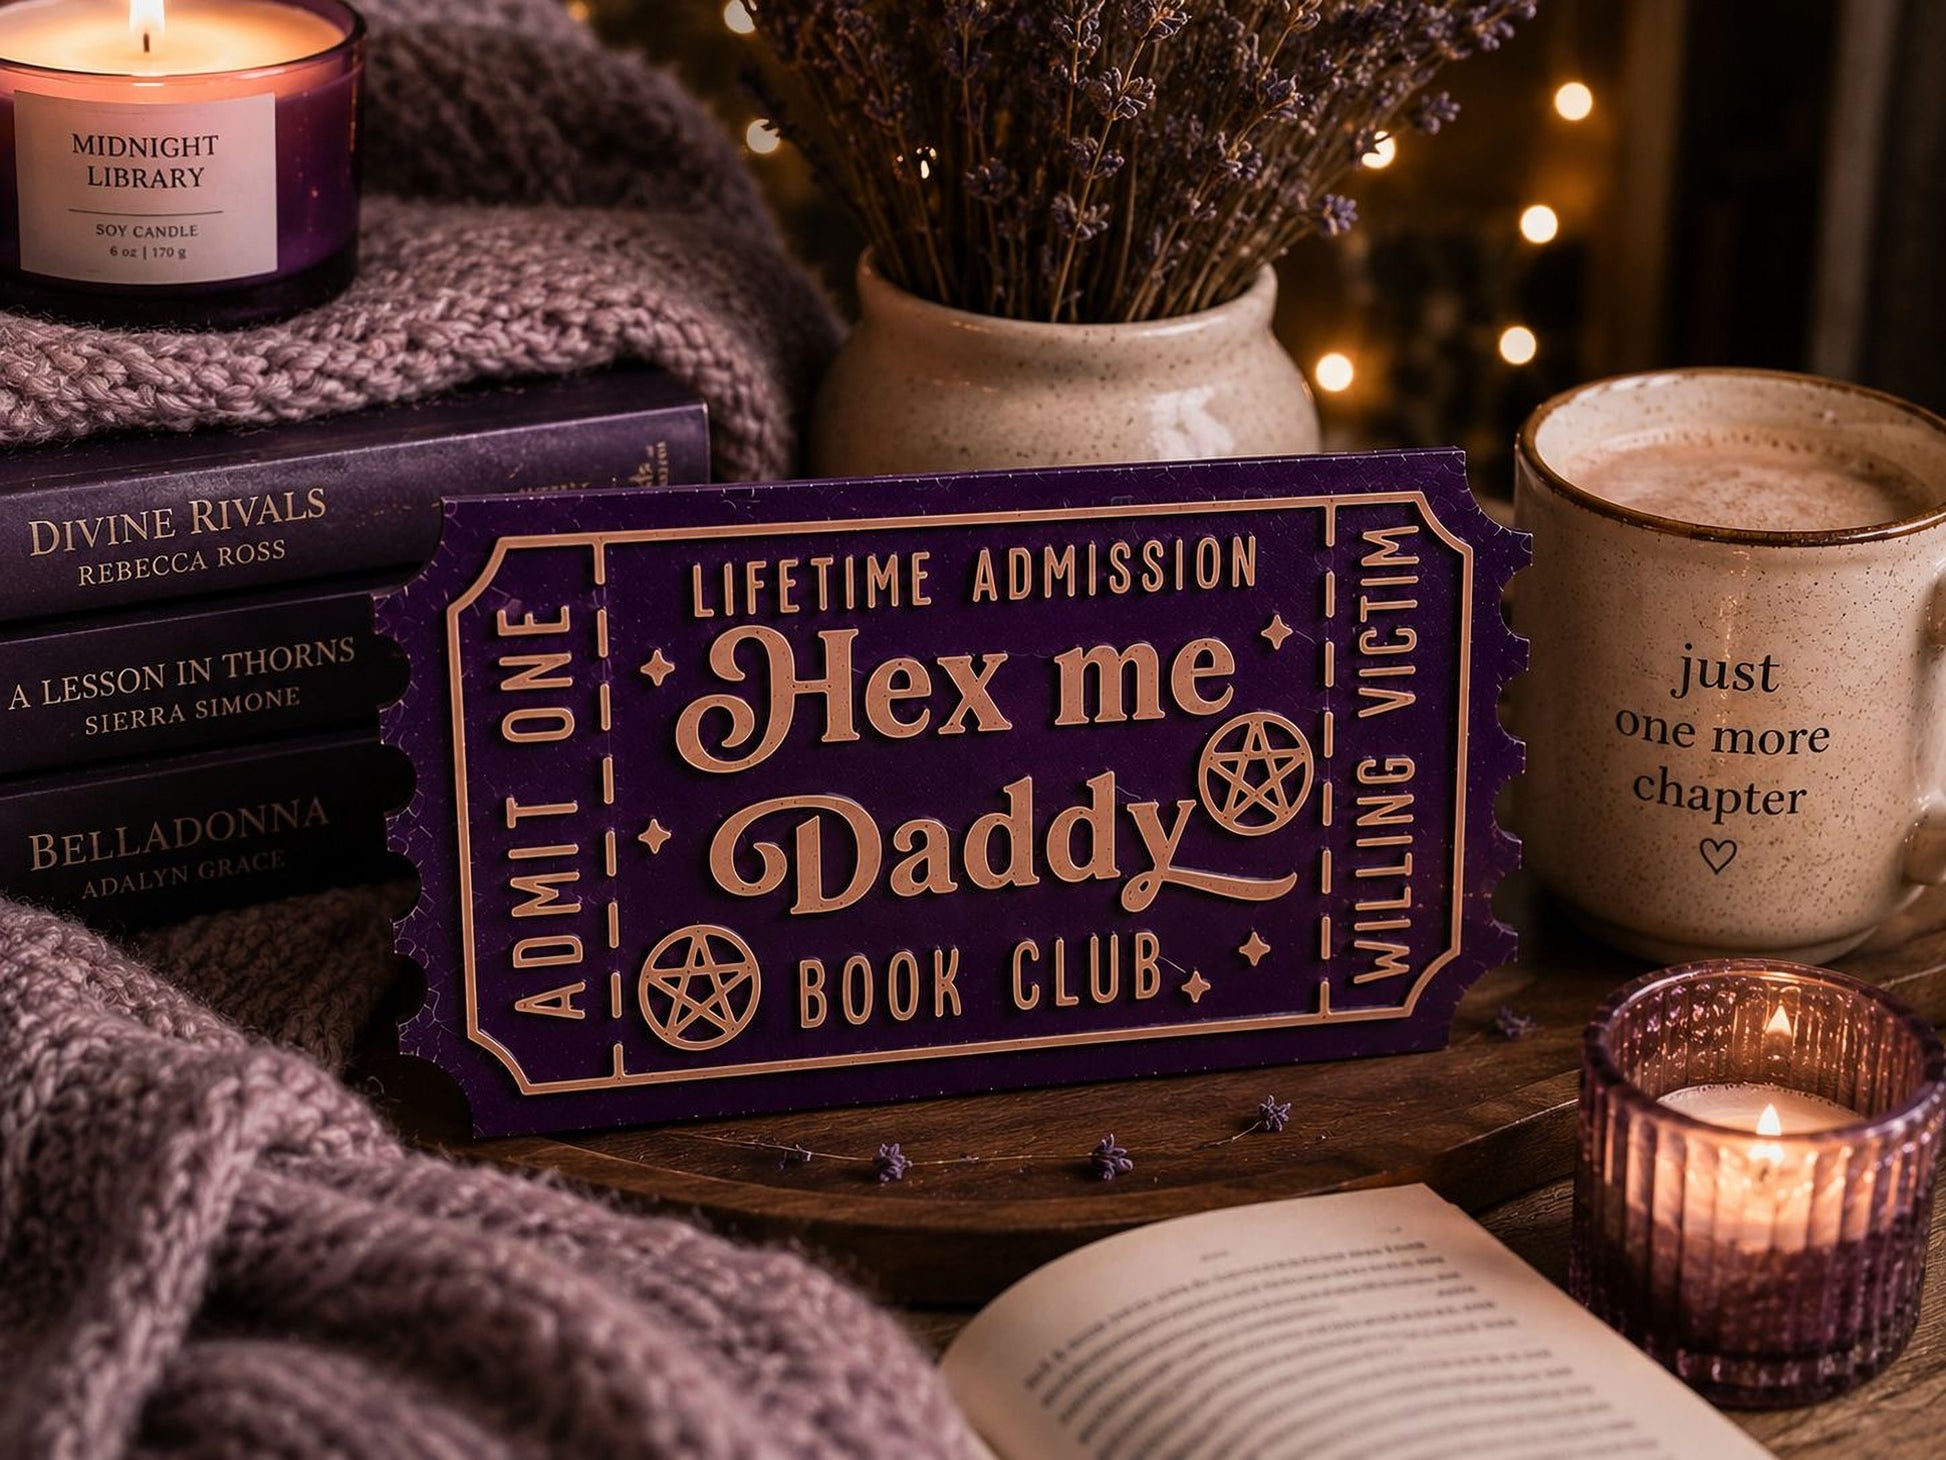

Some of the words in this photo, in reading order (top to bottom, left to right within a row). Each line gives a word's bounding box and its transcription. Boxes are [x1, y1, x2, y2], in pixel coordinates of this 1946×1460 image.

[72, 133, 219, 158] MIDNIGHT
[87, 166, 205, 189] LIBRARY
[96, 224, 127, 237] SOY
[133, 225, 199, 238] CANDLE
[110, 246, 118, 257] 6
[122, 248, 137, 258] oz
[152, 247, 174, 258] 170
[178, 249, 186, 259] g
[28, 509, 177, 557] DIVINE
[190, 487, 327, 534] RIVALS
[77, 551, 208, 588] REBECCA
[217, 539, 287, 567] ROSS
[692, 551, 932, 619] LIFETIME
[973, 534, 1257, 603] ADMISSION
[1357, 524, 1419, 719] VICTIM
[7, 683, 31, 711] A
[41, 663, 166, 706] LESSON
[176, 655, 212, 683] IN
[220, 636, 356, 677] THORNS
[497, 604, 575, 743] ONE
[675, 625, 1013, 773] Hex
[1054, 638, 1235, 727] me
[1671, 643, 1781, 699] just
[85, 705, 187, 735] SIERRA
[195, 686, 301, 720] SIMONE
[1615, 708, 1696, 749] one
[1711, 722, 1832, 756] more
[1633, 766, 1808, 824] chapter
[28, 797, 330, 872] BELLADONNA
[710, 771, 1298, 915] Daddy
[82, 865, 189, 900] ADALYN
[198, 850, 286, 880] GRACE
[1353, 755, 1417, 985] WILLING
[506, 796, 586, 1019] ADMIT
[800, 946, 963, 1029] BOOK
[1013, 931, 1163, 1010] CLUB
